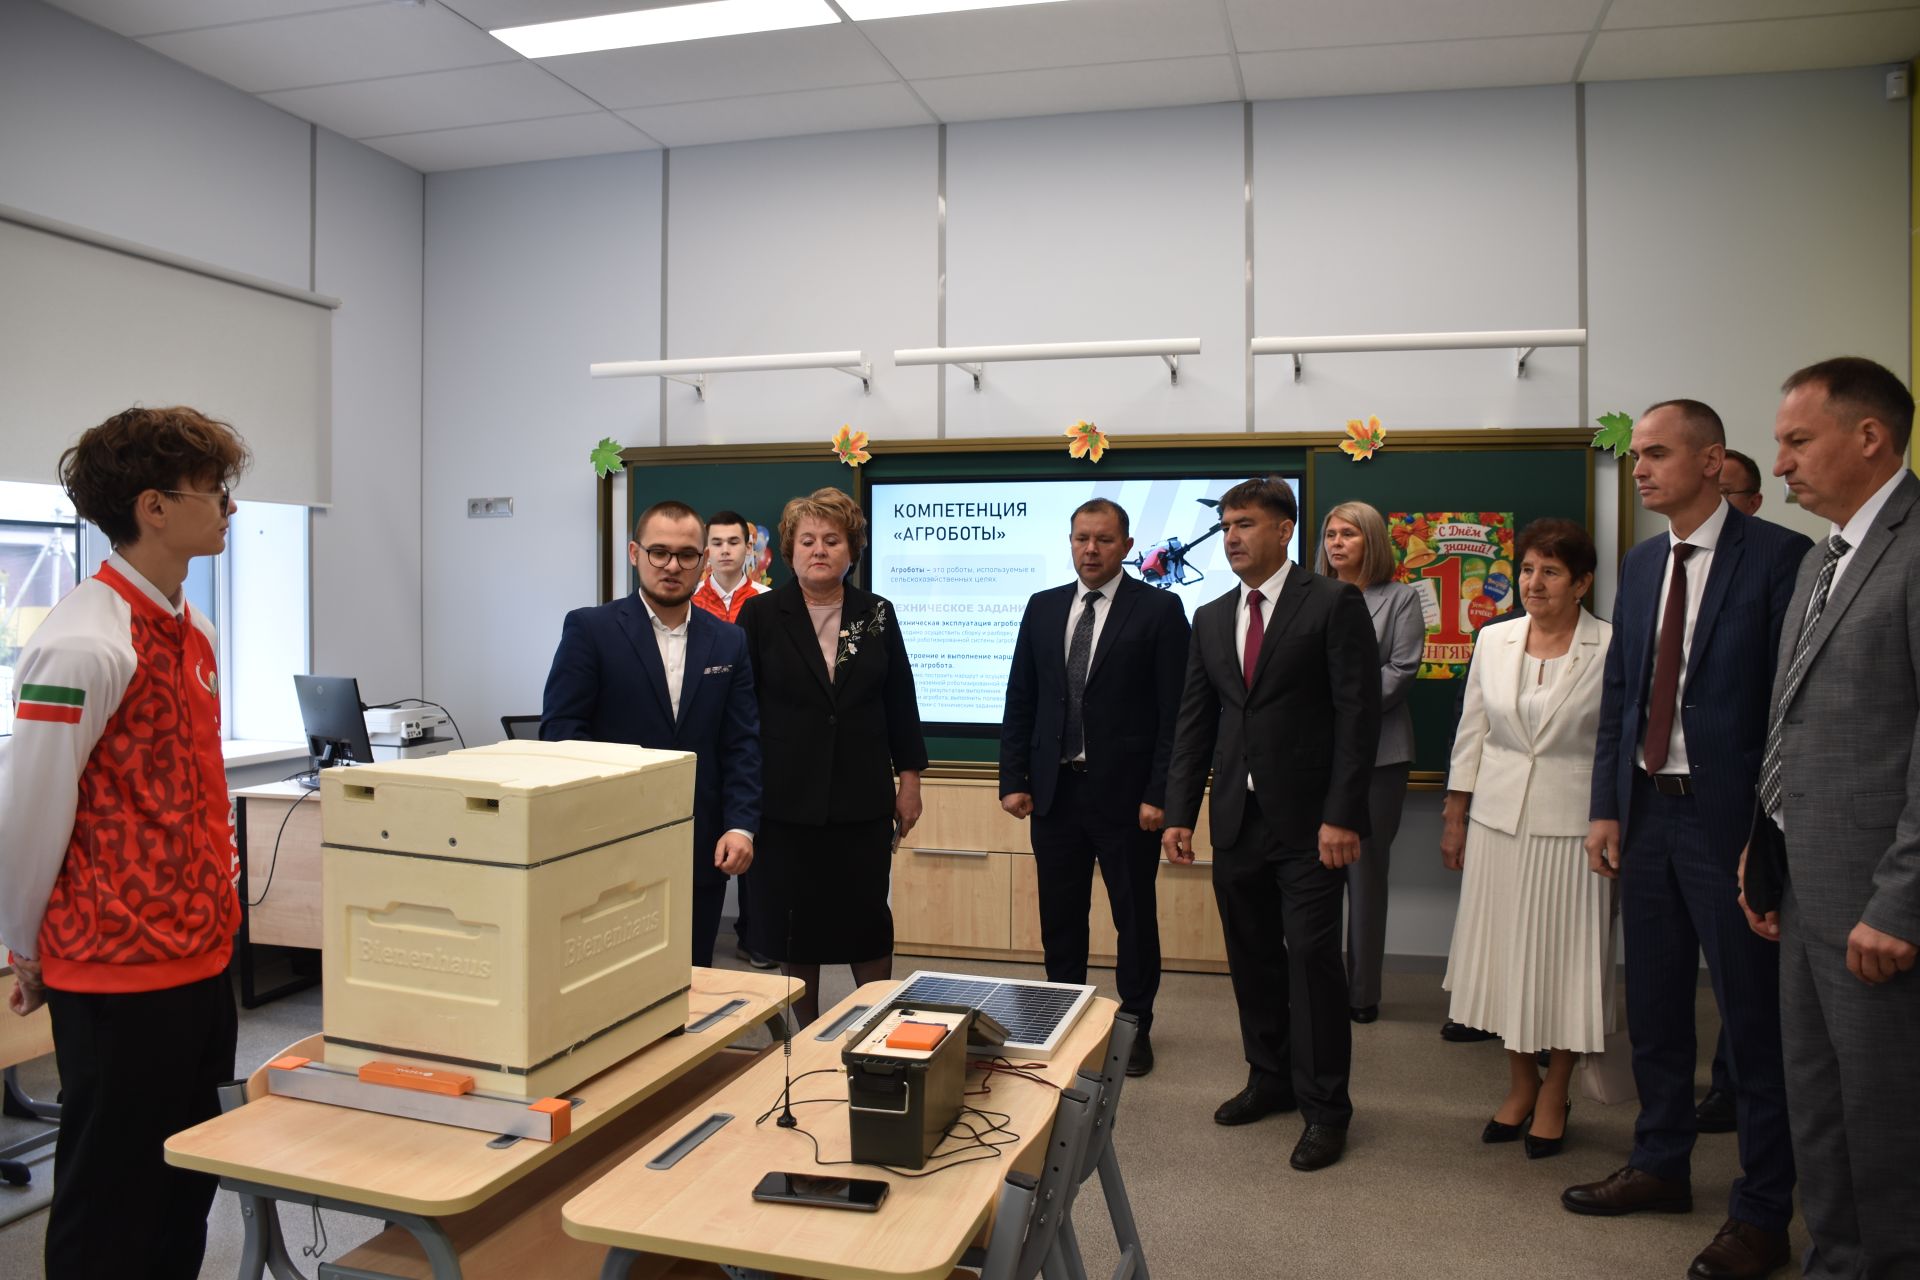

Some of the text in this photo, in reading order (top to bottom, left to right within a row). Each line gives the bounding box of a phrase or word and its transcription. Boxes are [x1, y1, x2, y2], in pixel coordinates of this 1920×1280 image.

[894, 502, 1027, 520] КОМПЕТЕНЦИЯ
[894, 526, 1006, 541] «АГРОБОТЫ»
[1438, 525, 1481, 538] С Днём
[1443, 543, 1493, 556] знаний!
[890, 566, 925, 575] Агроботы
[976, 567, 1029, 575] используемые
[1421, 556, 1472, 645] 1
[894, 603, 1026, 614] ЕХНИЧЕСКОЕ ЗАДАНИ
[942, 620, 992, 628] эксплуатация
[993, 620, 1022, 628] агробот
[1423, 645, 1473, 659] НТЯБ
[565, 910, 660, 968] Bienenhaus
[358, 937, 492, 979] Bienenhaus
